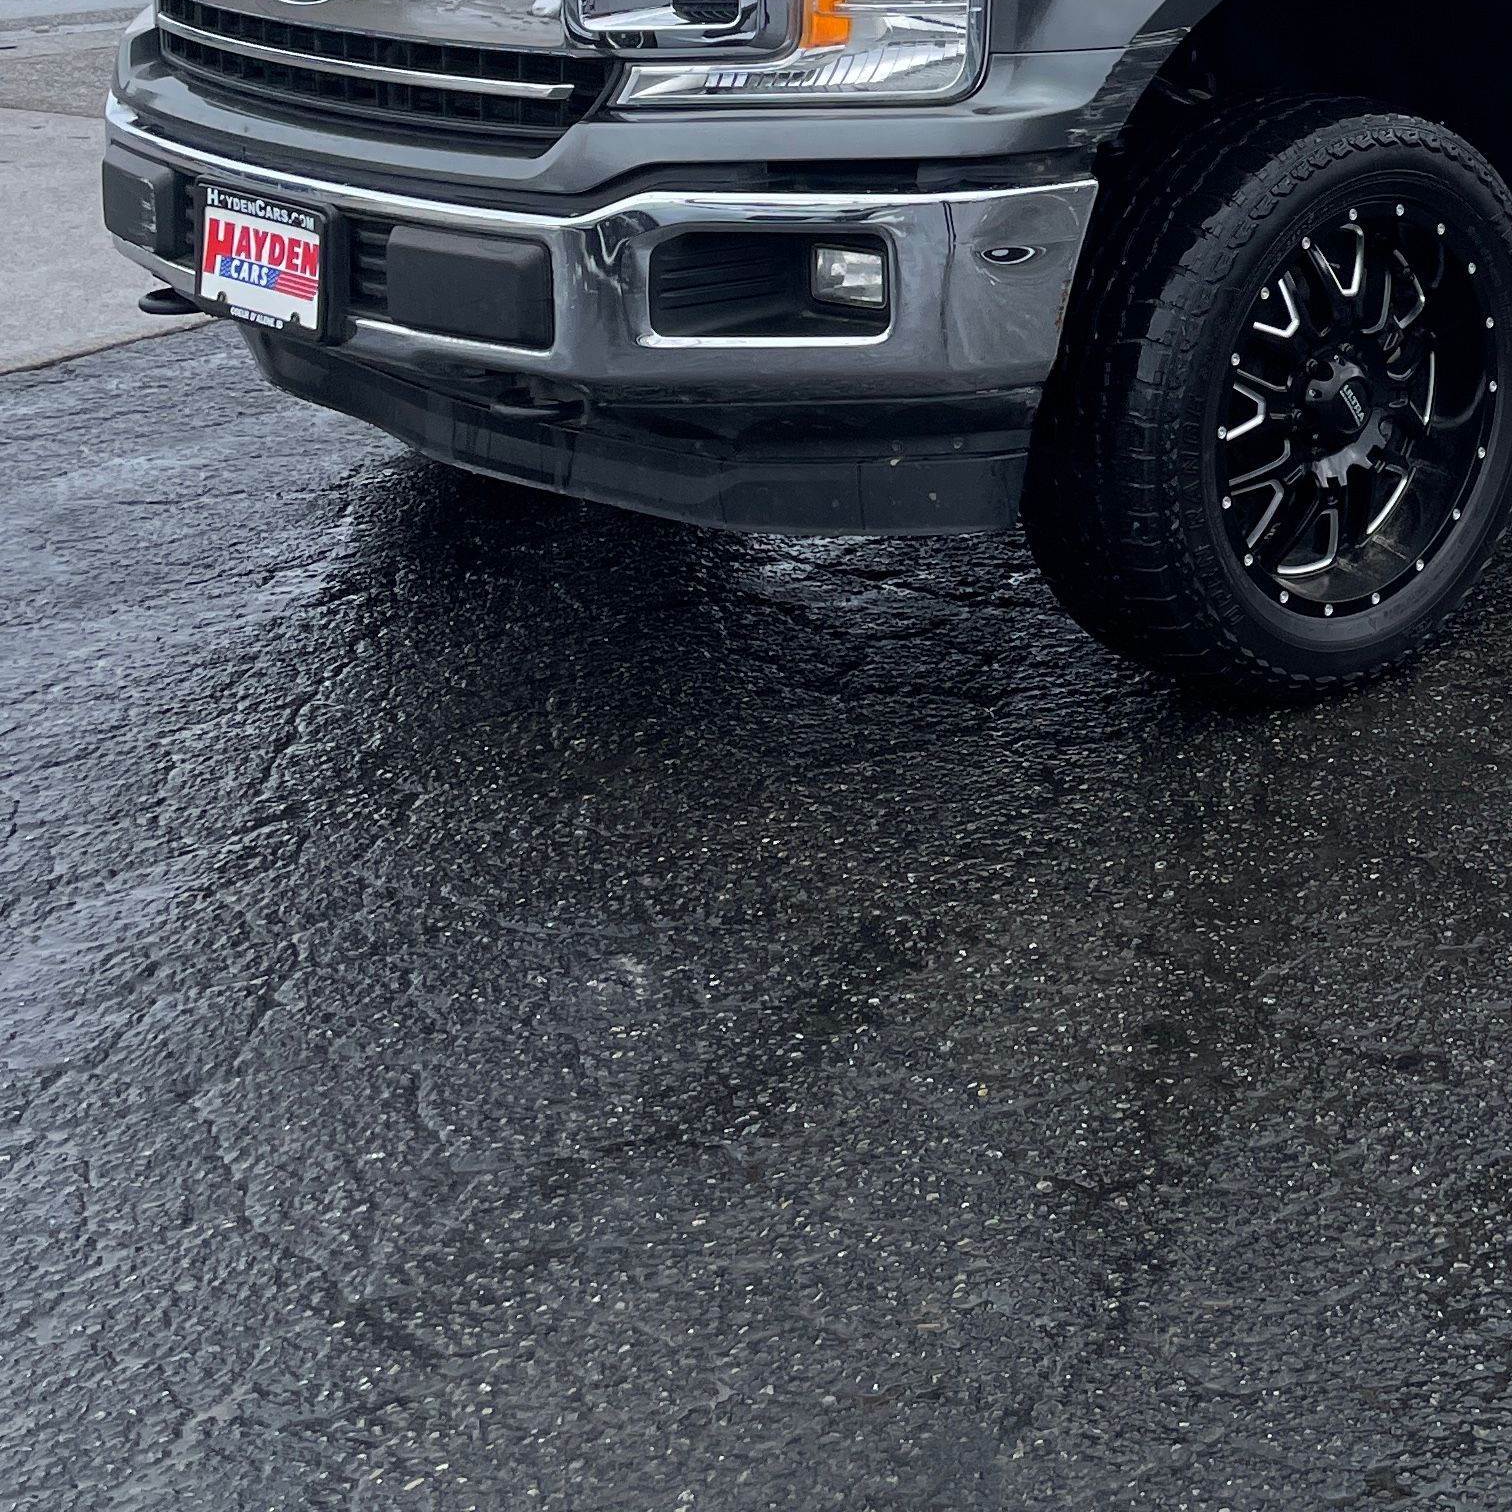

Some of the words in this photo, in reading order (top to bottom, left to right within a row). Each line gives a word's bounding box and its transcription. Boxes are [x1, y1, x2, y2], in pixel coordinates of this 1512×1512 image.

[207, 187, 315, 231] HYDENCARS.COM
[203, 218, 319, 277] HAYDEN
[230, 259, 269, 286] CARS
[1343, 384, 1365, 423] ULTRA
